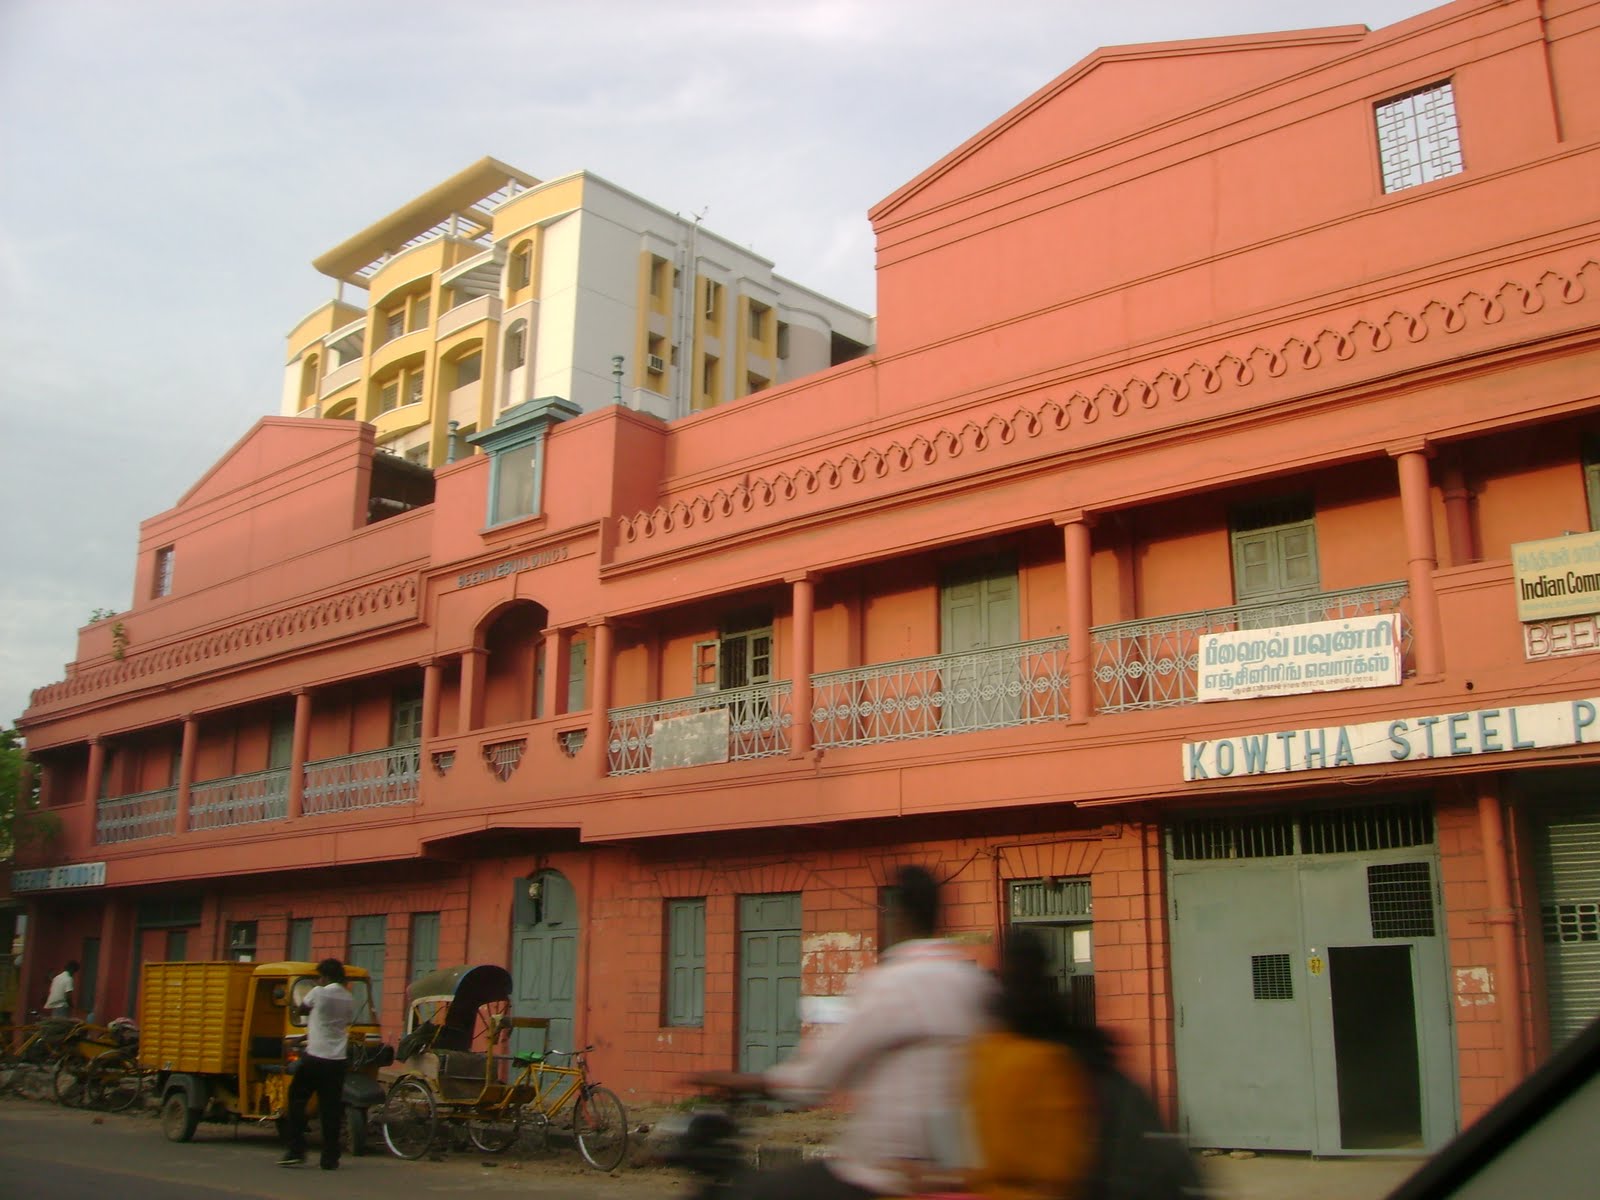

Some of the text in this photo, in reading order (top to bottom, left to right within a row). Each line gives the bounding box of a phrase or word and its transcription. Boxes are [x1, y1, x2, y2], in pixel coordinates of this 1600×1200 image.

[1520, 575, 1566, 600] Indian
[1189, 727, 1355, 779] KOWTHA
[1387, 708, 1535, 760] STEEL
